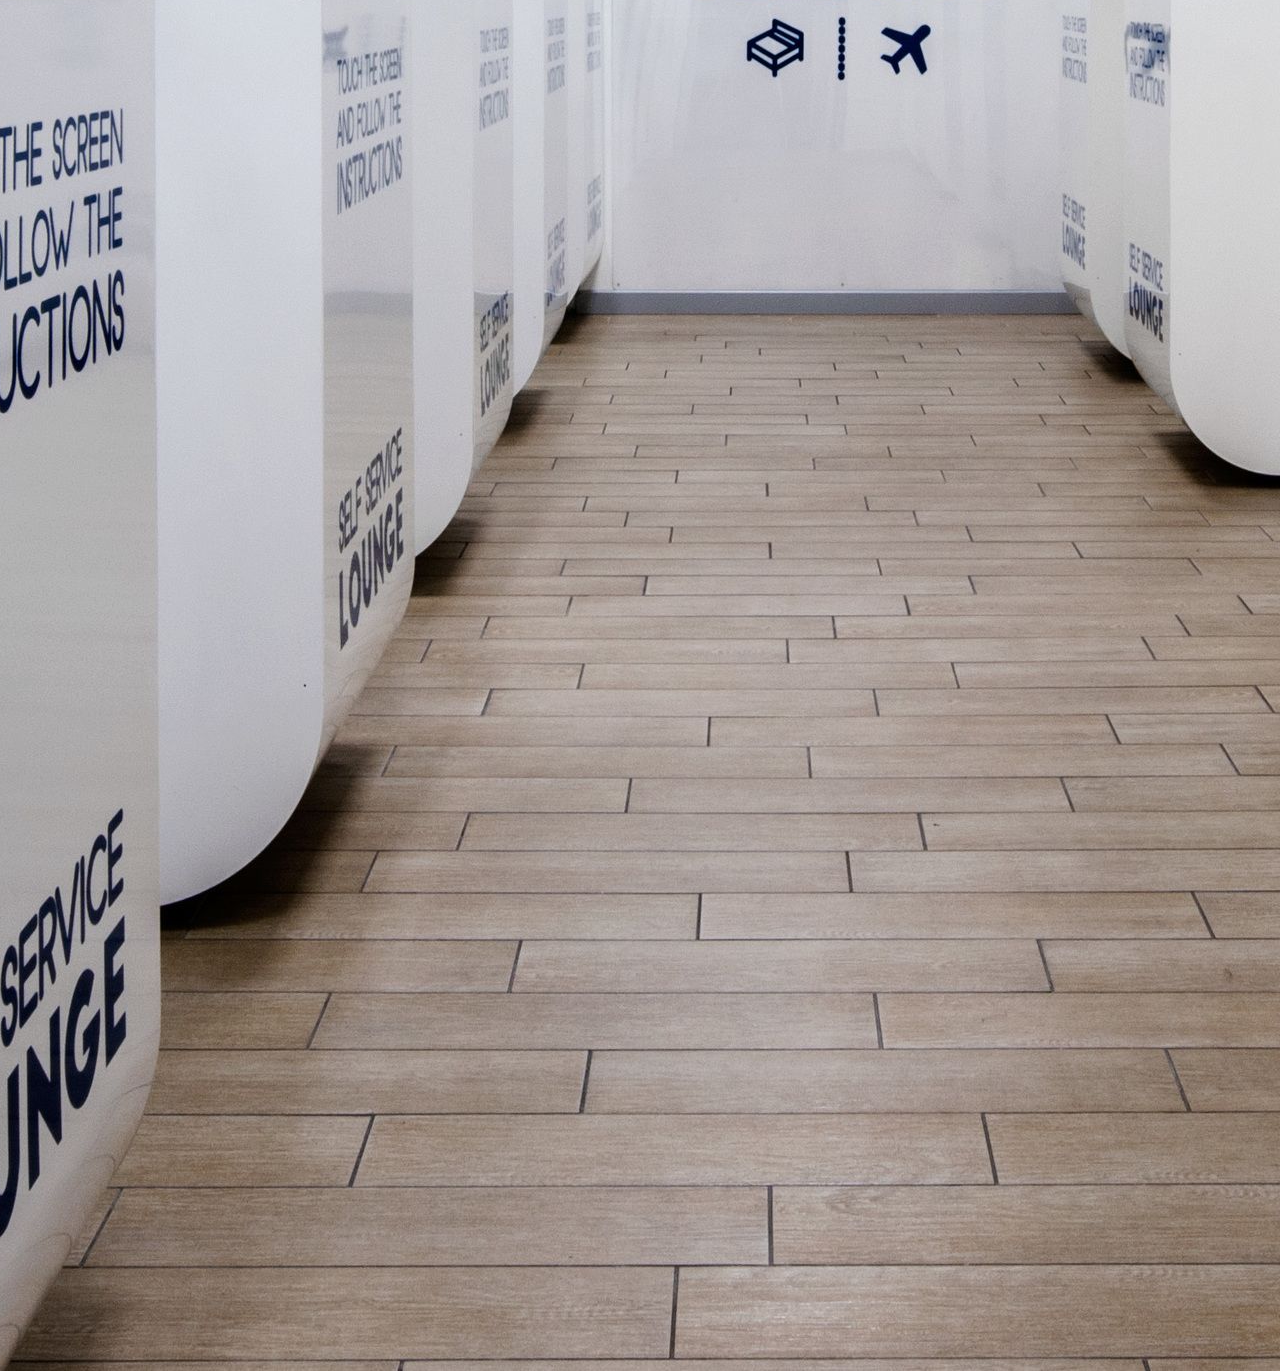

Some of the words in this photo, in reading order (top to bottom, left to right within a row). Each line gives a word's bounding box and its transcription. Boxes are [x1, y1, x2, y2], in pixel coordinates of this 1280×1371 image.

[336, 55, 363, 95] TOUCH
[365, 52, 378, 86] THE
[52, 108, 124, 180] SCREEN
[336, 106, 354, 149] AND
[356, 95, 387, 140] FOLLOW
[388, 90, 402, 126] THE
[336, 134, 403, 216] INSTRUCTIONS
[83, 186, 123, 258] THE
[339, 477, 362, 554] SELF
[366, 427, 403, 516] SERVICE
[339, 486, 404, 651] LOUNGE
[1, 808, 124, 1048] SERVICE
